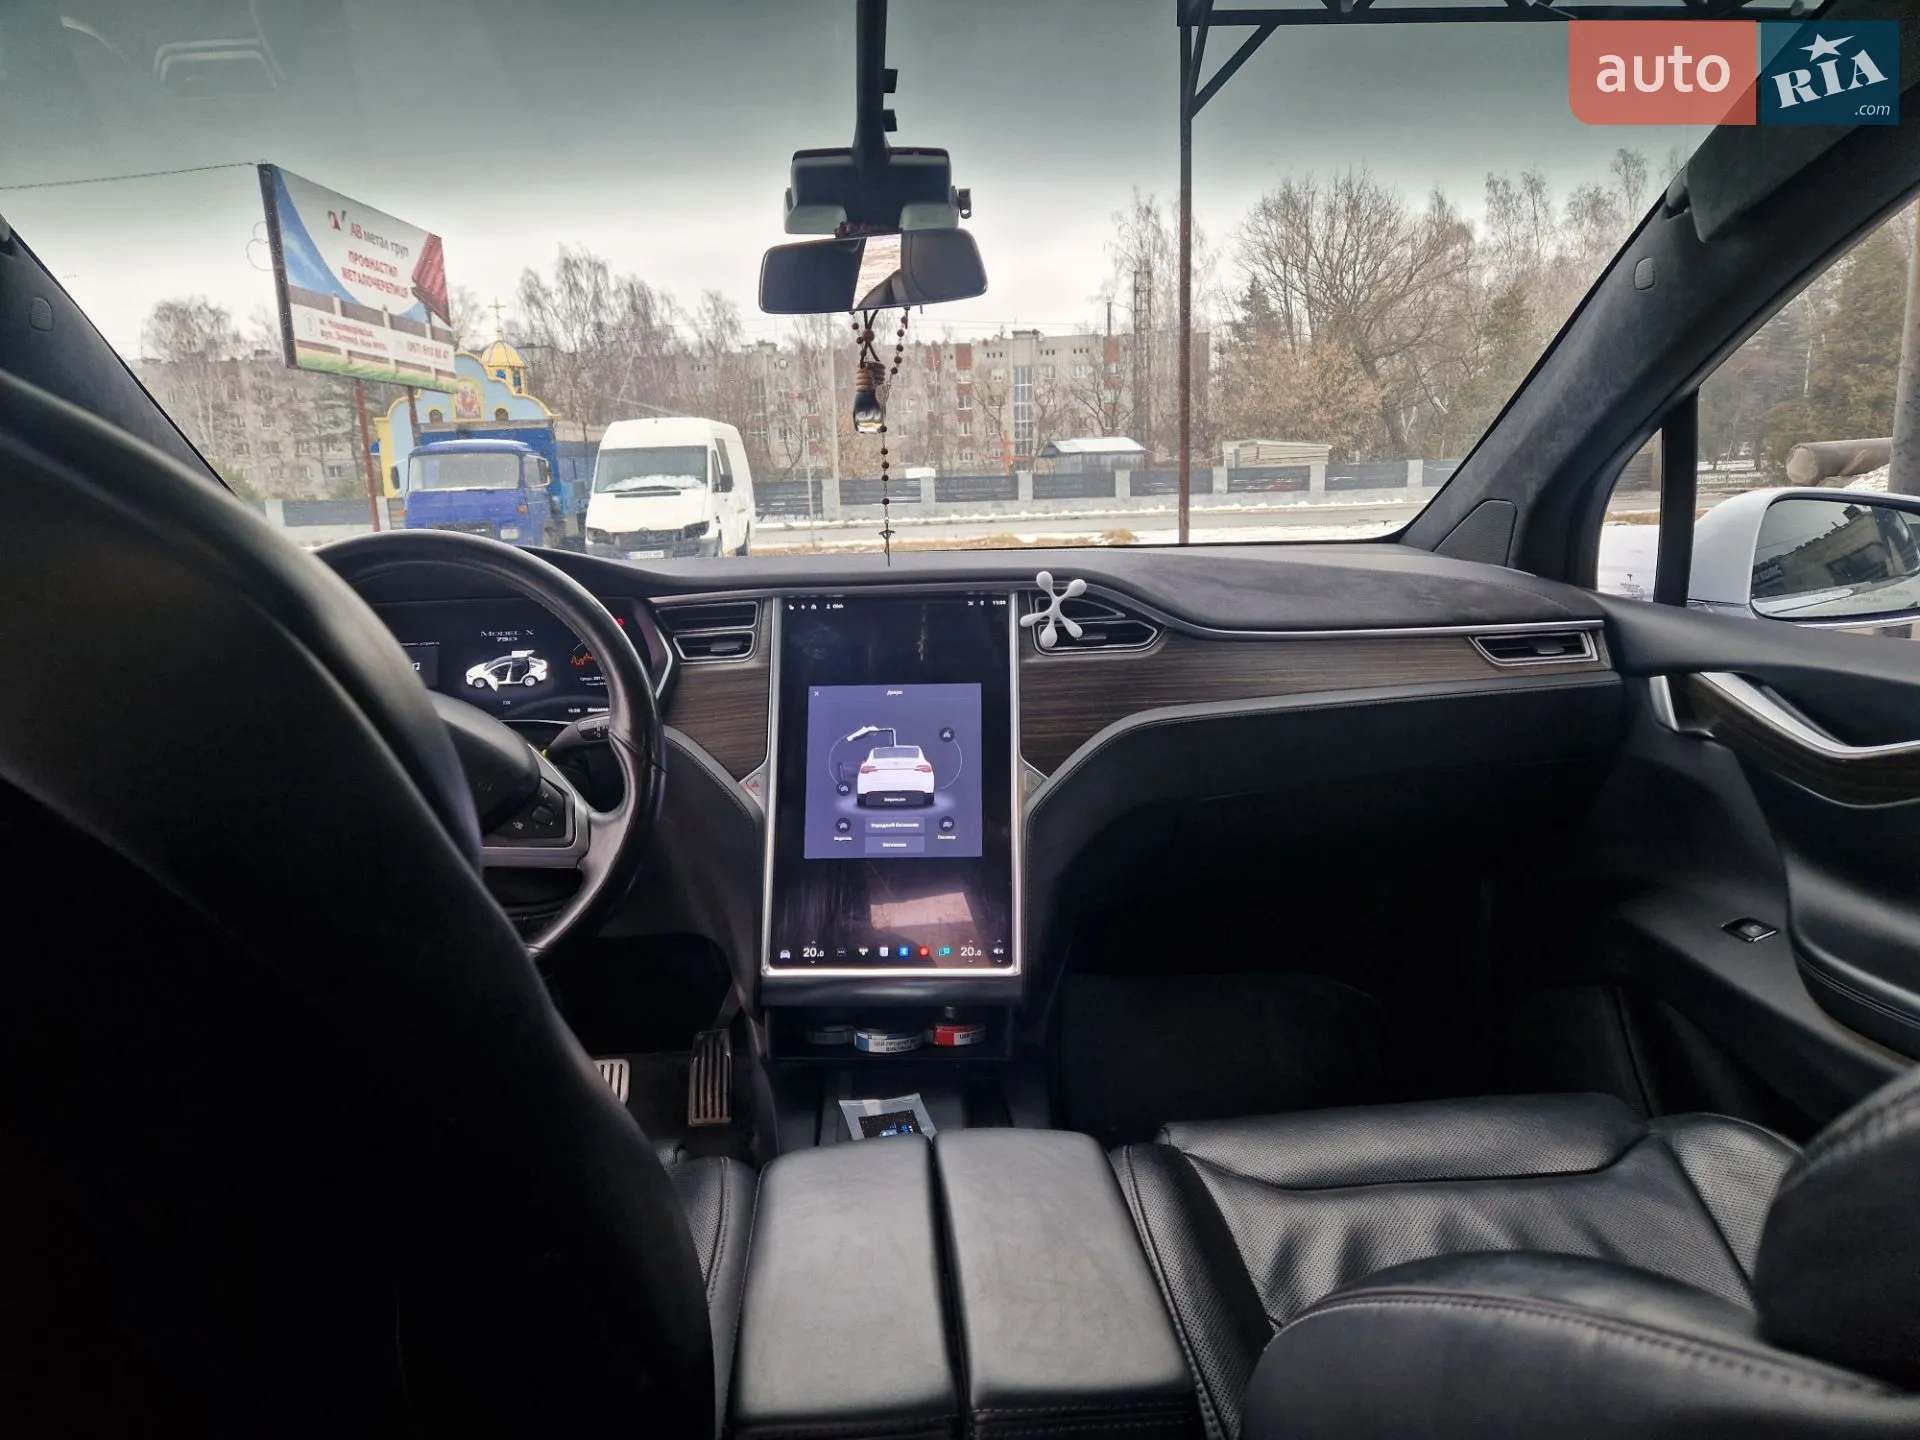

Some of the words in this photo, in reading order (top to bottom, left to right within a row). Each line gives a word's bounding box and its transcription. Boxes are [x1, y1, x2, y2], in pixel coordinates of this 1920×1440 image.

[363, 230, 390, 251] метал
[390, 242, 409, 259] груп
[348, 250, 398, 277] ПРОФНАСТИЛ
[341, 266, 409, 298] МЕТАЛОЧЕРЕПИЦЯ
